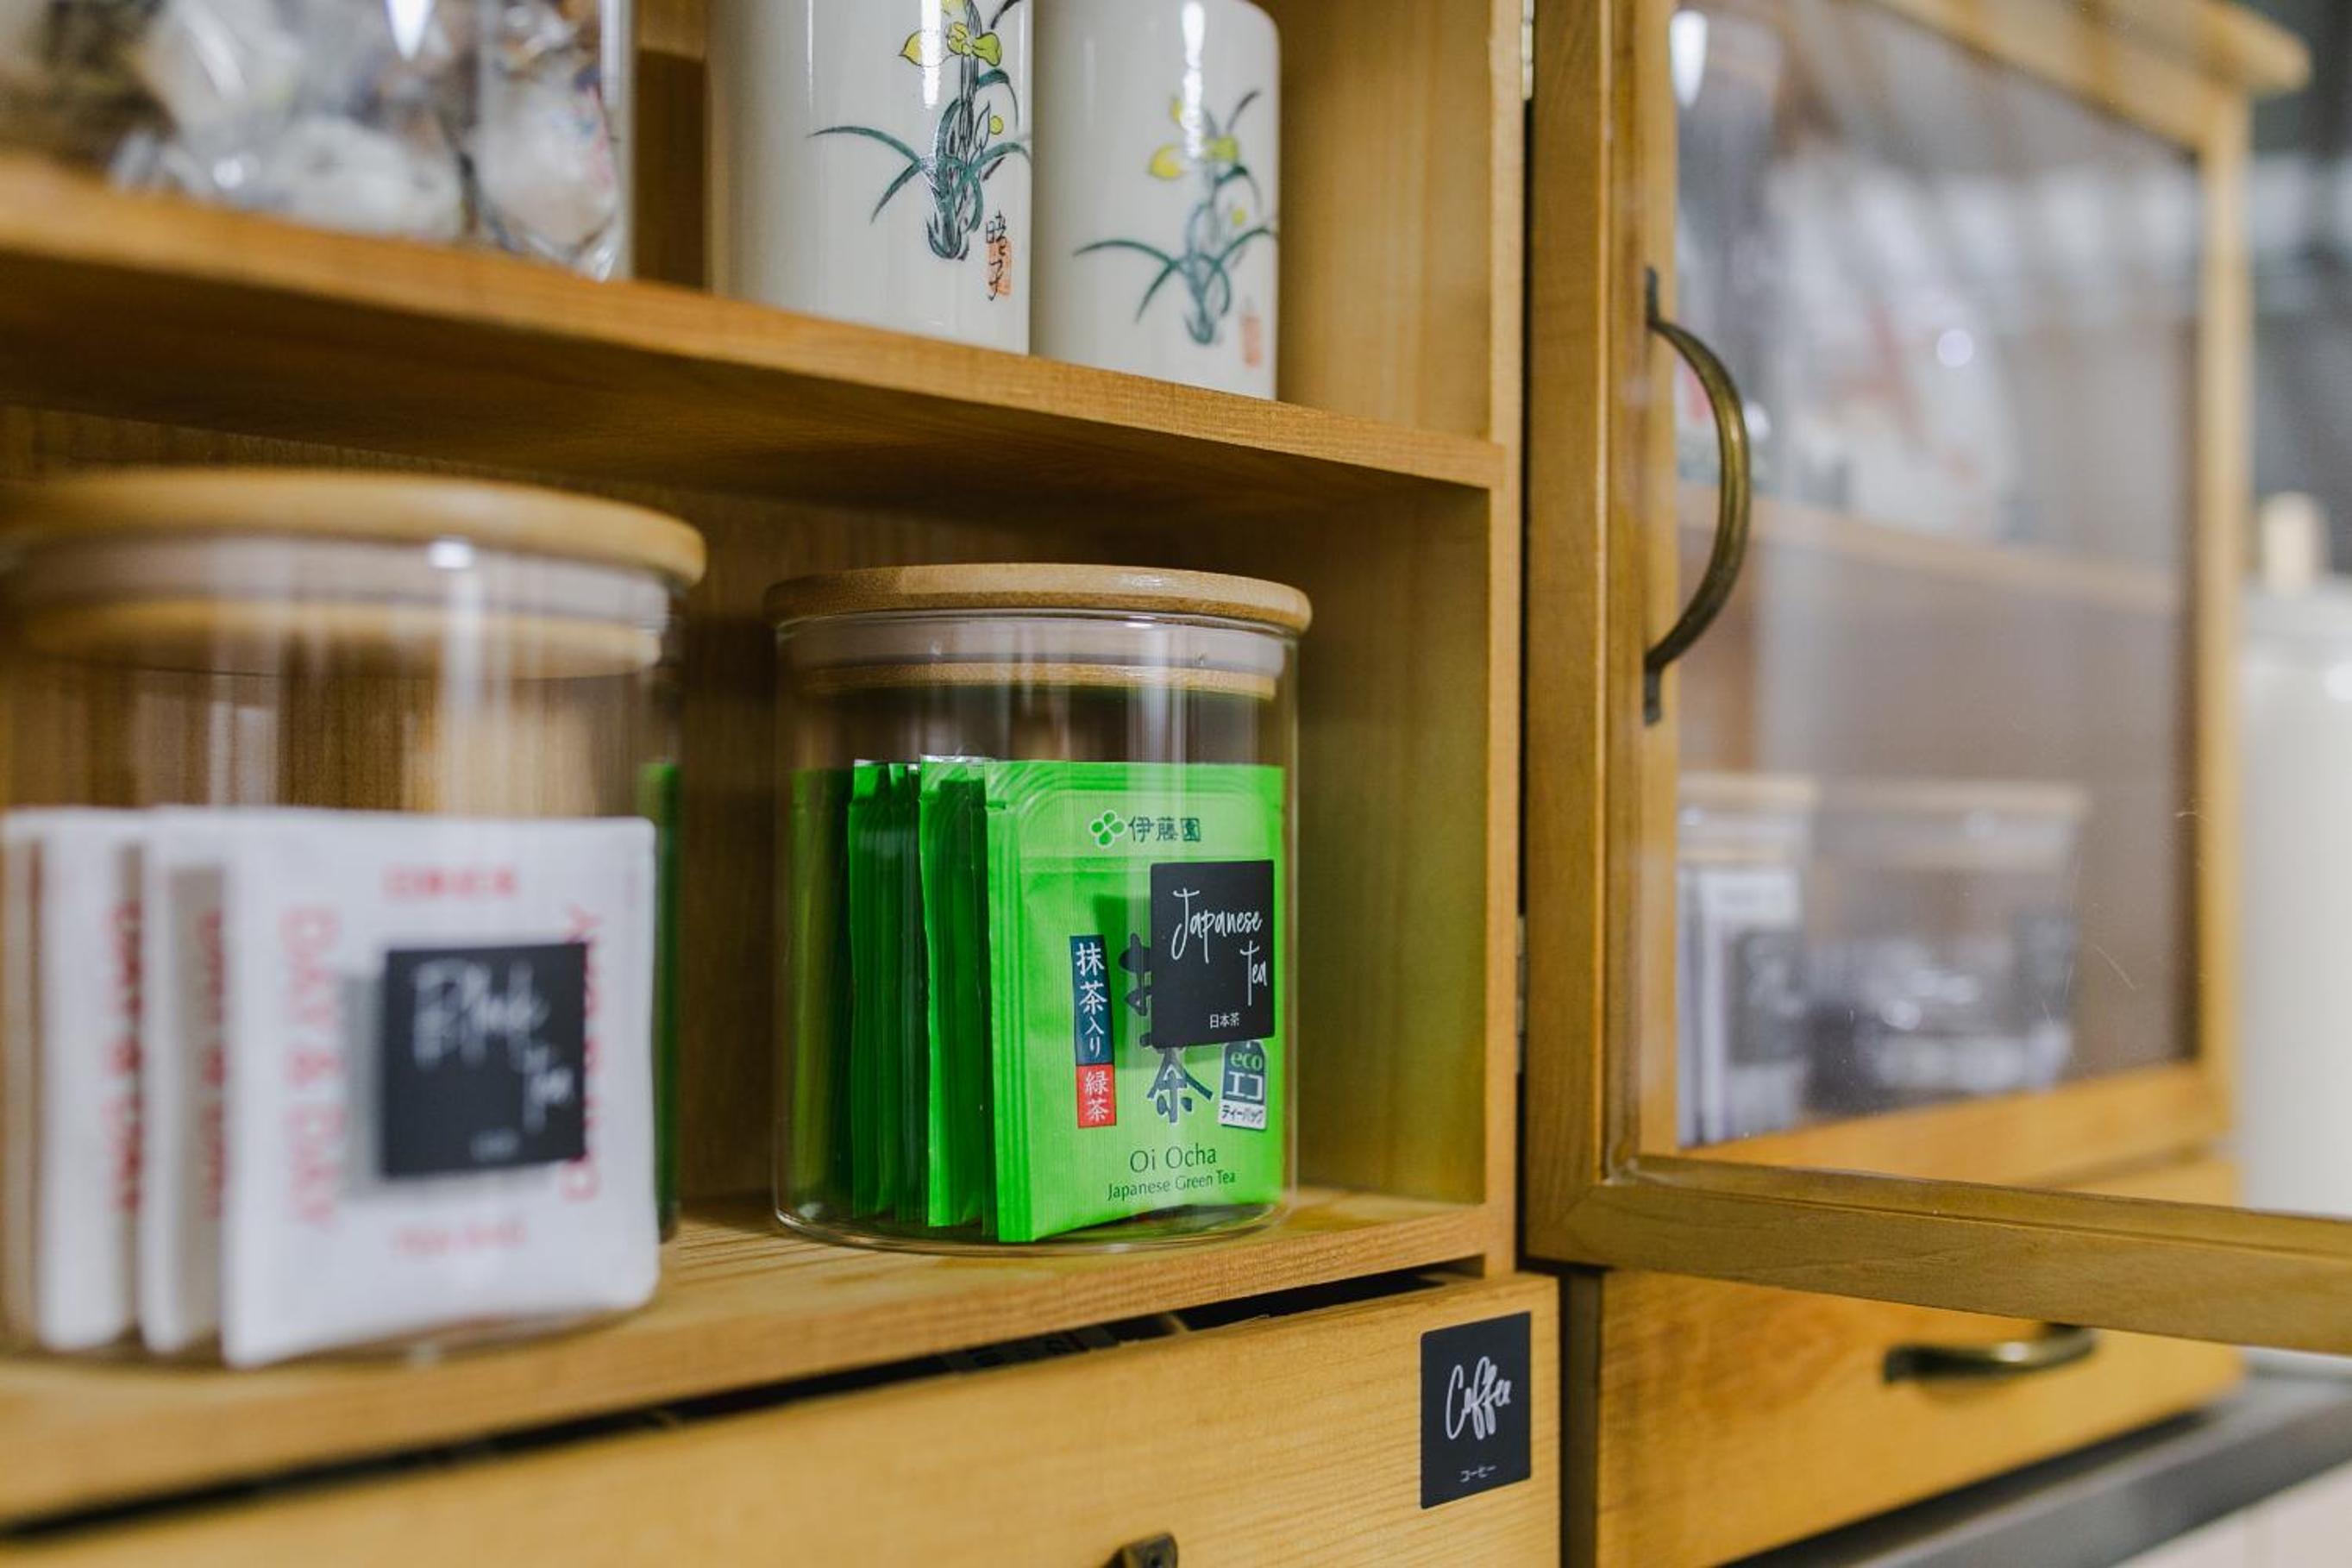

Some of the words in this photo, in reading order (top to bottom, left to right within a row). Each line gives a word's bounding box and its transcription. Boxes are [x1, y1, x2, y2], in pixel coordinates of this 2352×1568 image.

[1128, 816, 1201, 843] 伊藤園
[1171, 887, 1264, 964] Japanese
[1076, 942, 1108, 1057] 抹茶入り
[1209, 1013, 1240, 1029] 日本茶
[1230, 1051, 1264, 1070] eco
[1084, 1070, 1109, 1122] 緑茶
[1225, 1070, 1264, 1101] エコ
[1130, 1148, 1156, 1173] Oi
[1166, 1142, 1217, 1169] Ocha
[1107, 1179, 1170, 1201] Japanese
[1176, 1175, 1214, 1190] Green
[1216, 1169, 1236, 1185] Tea
[1460, 1465, 1497, 1483] コーヒー
